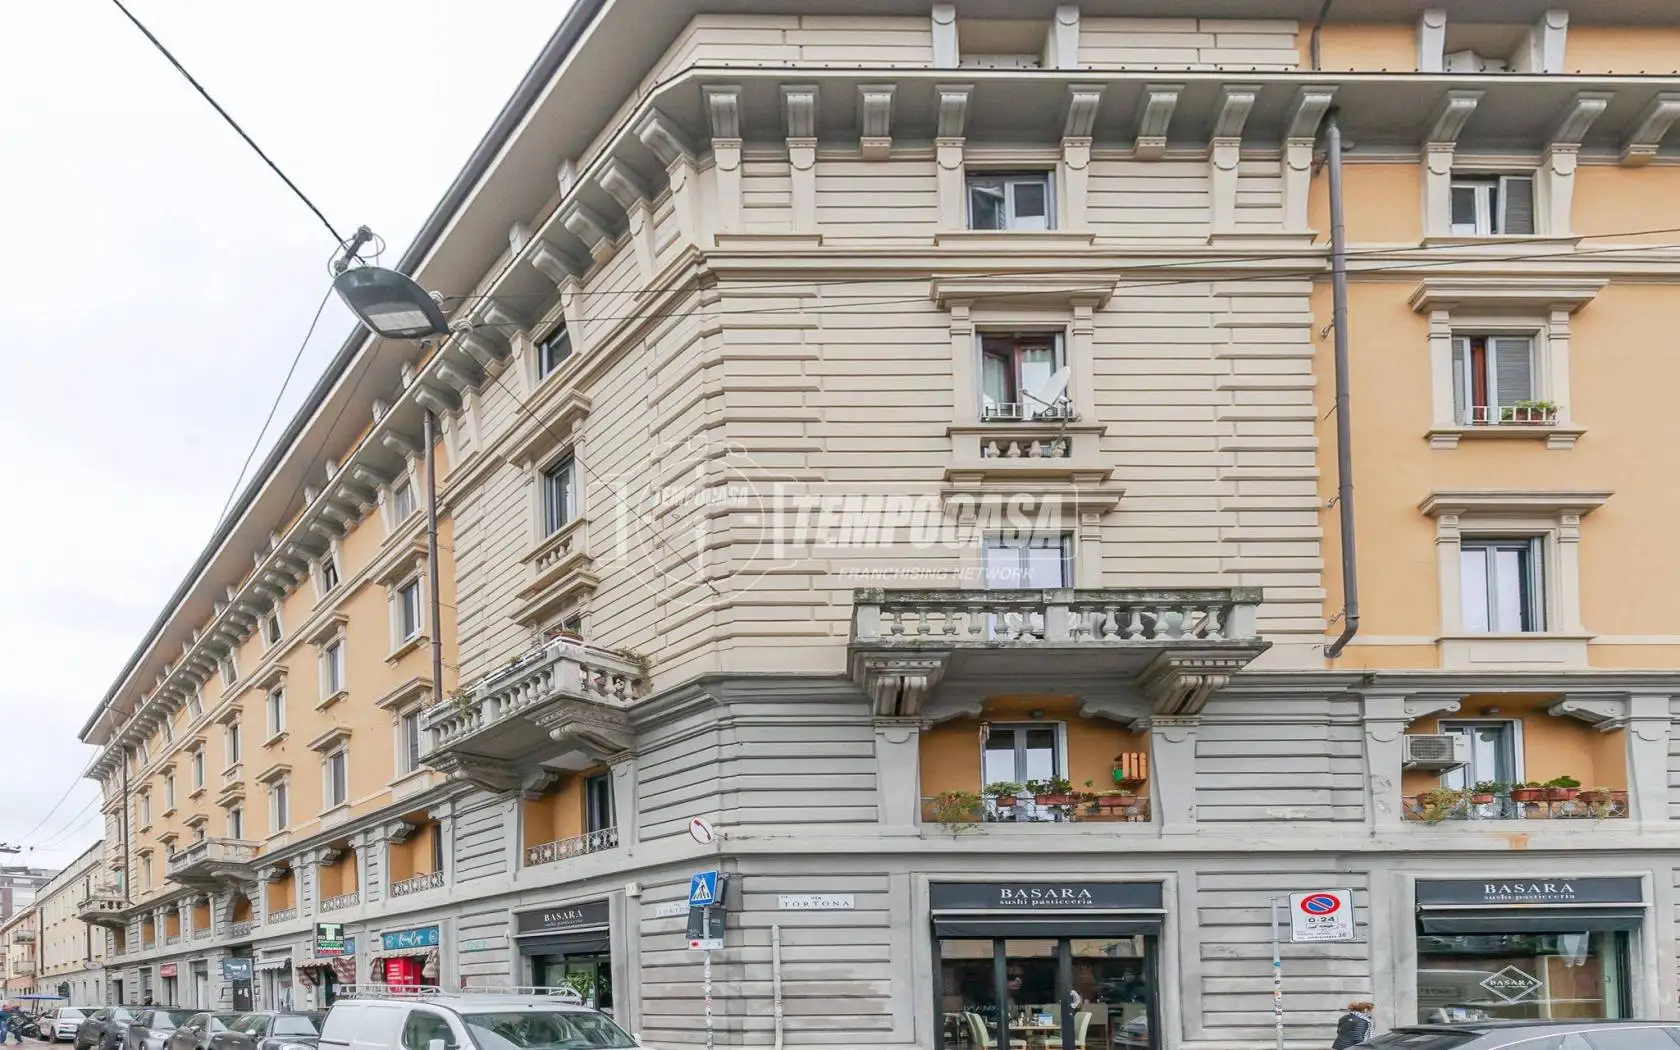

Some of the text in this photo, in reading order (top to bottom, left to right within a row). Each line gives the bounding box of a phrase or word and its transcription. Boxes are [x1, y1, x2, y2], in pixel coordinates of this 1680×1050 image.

[1000, 888, 1092, 898] BASARA
[1484, 883, 1575, 894] BASARA
[543, 909, 584, 922] BASARA
